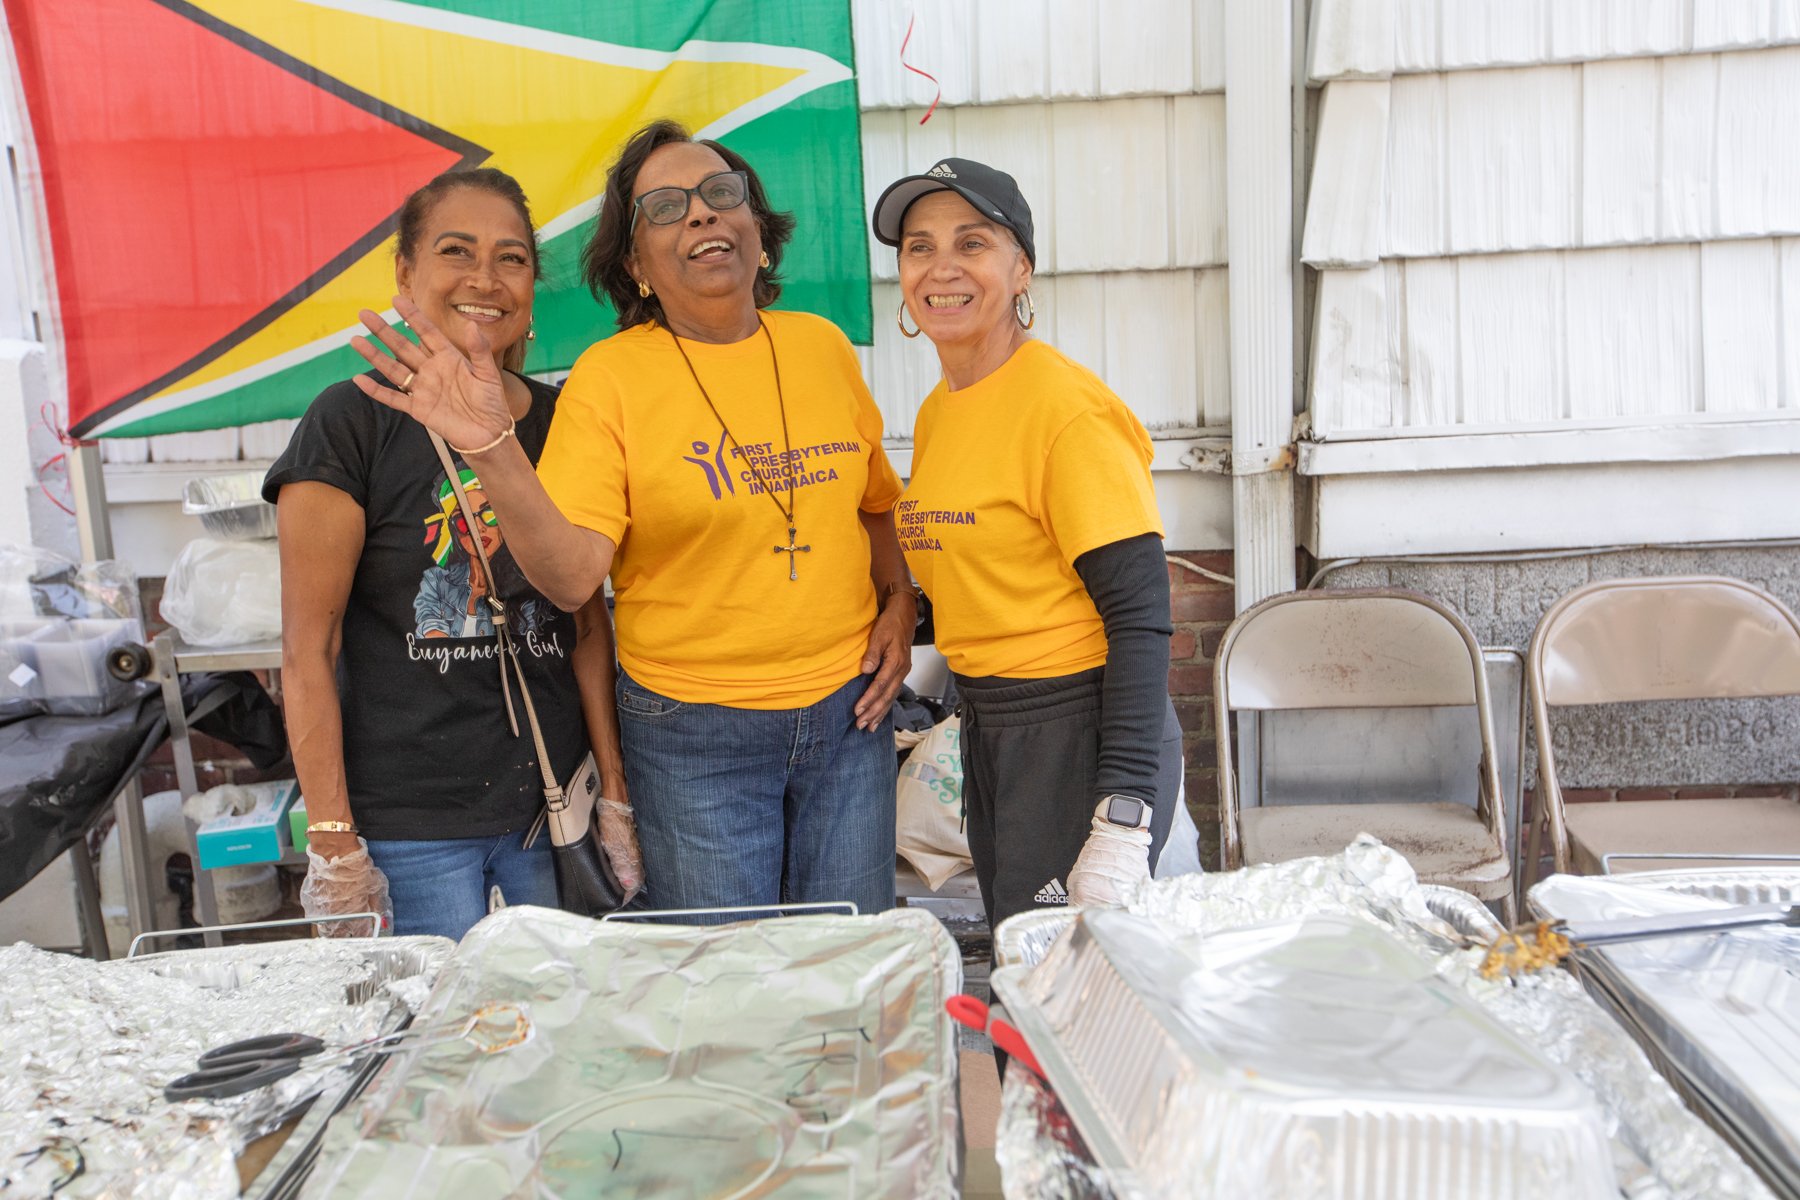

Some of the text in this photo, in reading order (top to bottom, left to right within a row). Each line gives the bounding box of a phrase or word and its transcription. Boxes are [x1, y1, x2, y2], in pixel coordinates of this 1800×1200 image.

[730, 443, 772, 459] FIRST
[750, 442, 860, 468] PRESBYTERIAN
[740, 462, 805, 483] CHURCH
[748, 468, 838, 495] IN JAMAICA
[898, 500, 919, 513] FIRST
[901, 511, 976, 525] PRESBYTERIAN
[526, 630, 564, 658] Girl
